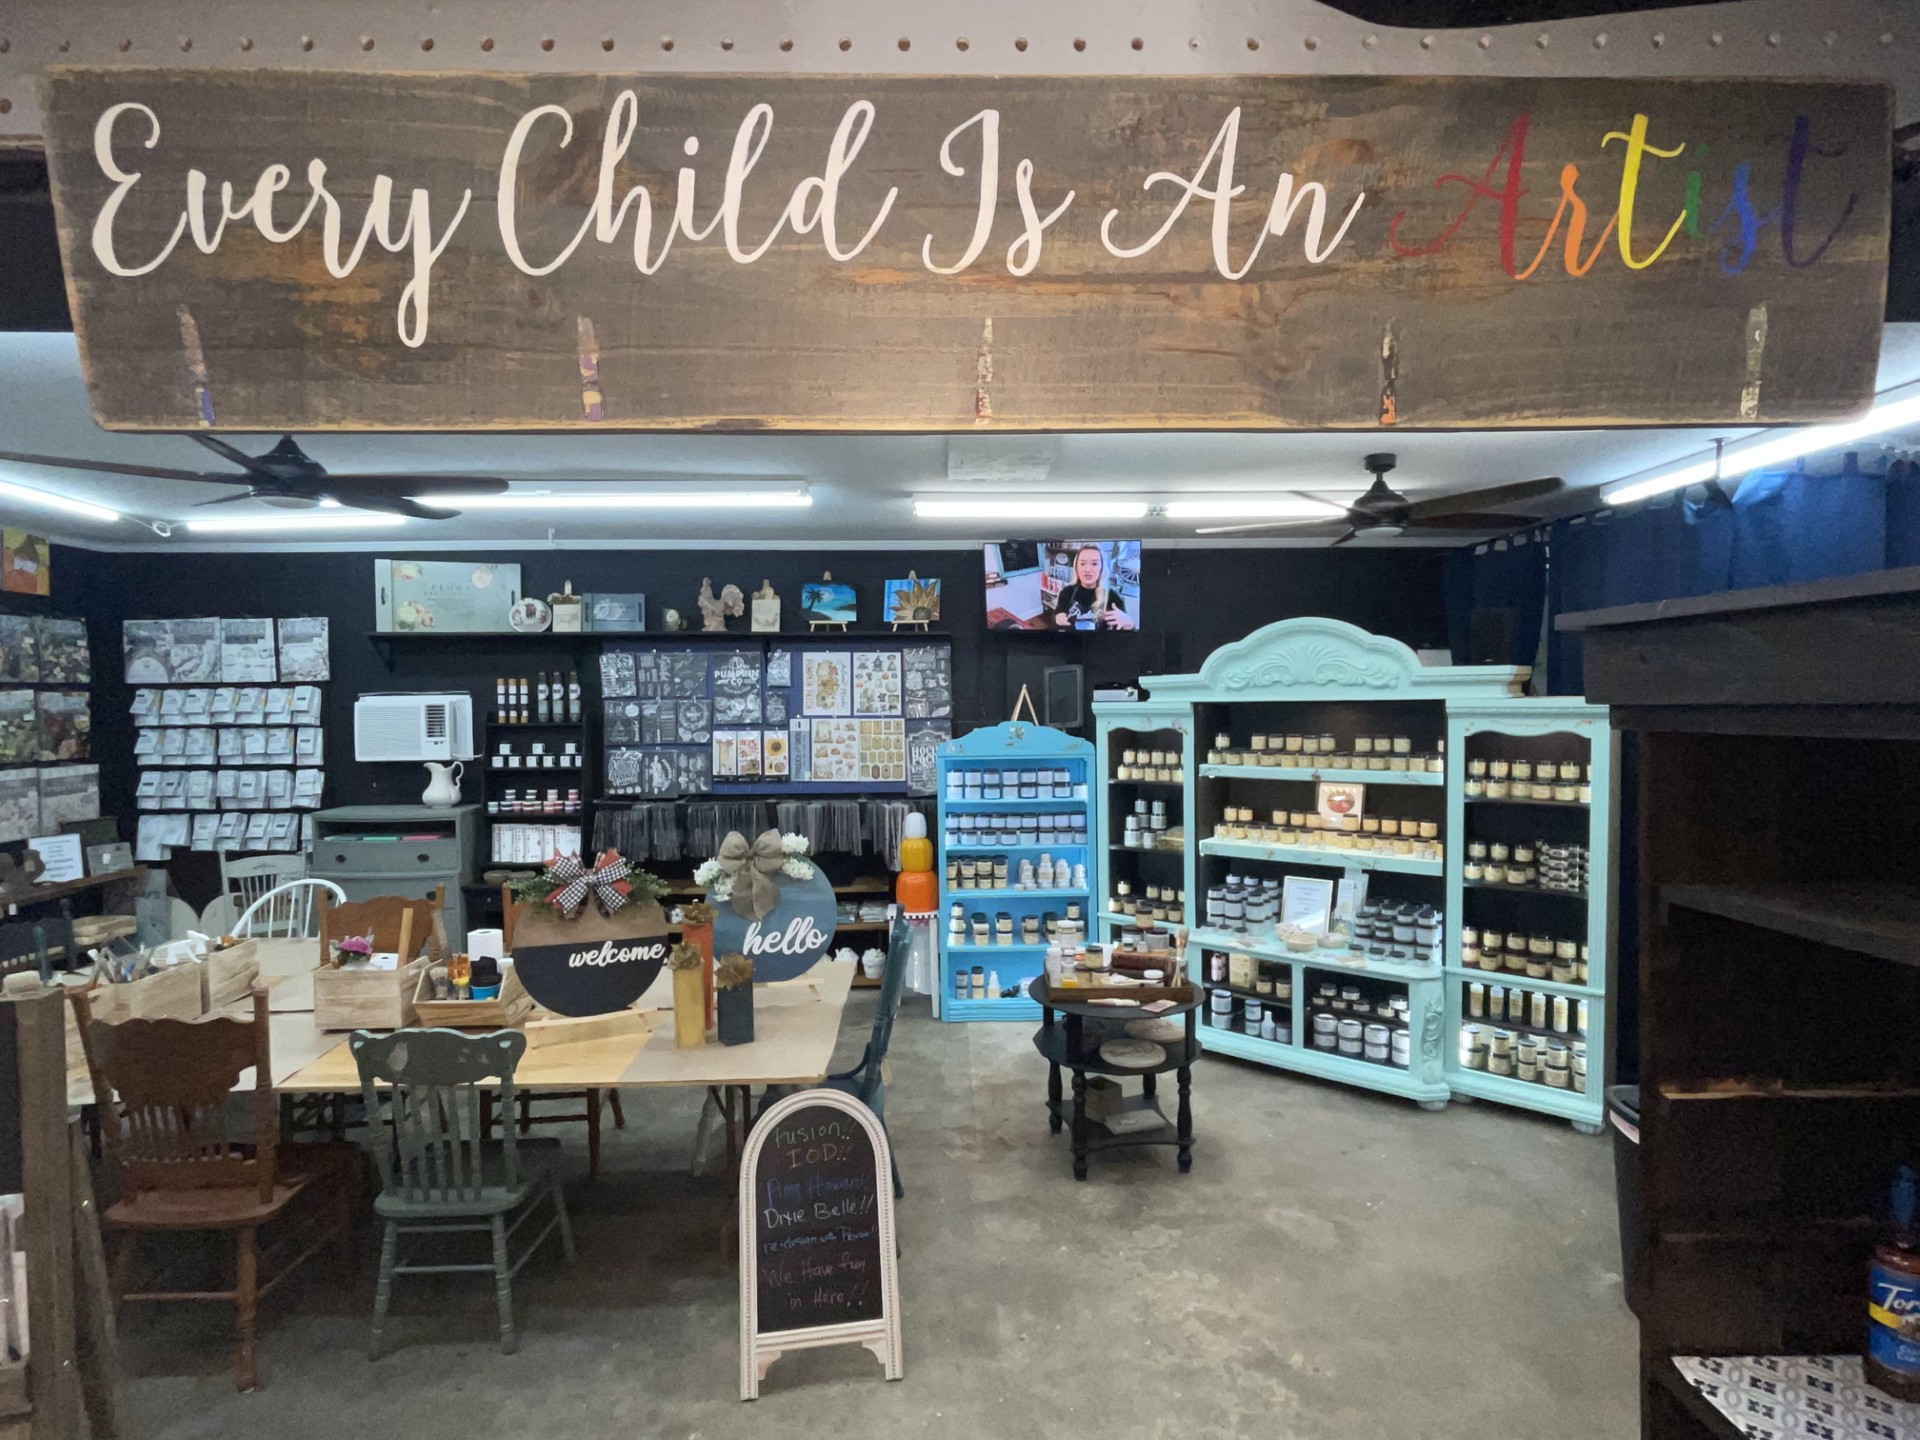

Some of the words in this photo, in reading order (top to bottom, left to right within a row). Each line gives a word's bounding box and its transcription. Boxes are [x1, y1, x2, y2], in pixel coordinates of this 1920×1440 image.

[91, 102, 472, 348] Every
[498, 89, 898, 277] Child
[922, 108, 1075, 278] Is
[1101, 106, 1365, 279] An
[1389, 112, 1857, 280] Artist
[743, 916, 828, 956] hello
[569, 941, 665, 968] welcome
[763, 1207, 806, 1229] Dixie
[762, 1257, 795, 1287] We
